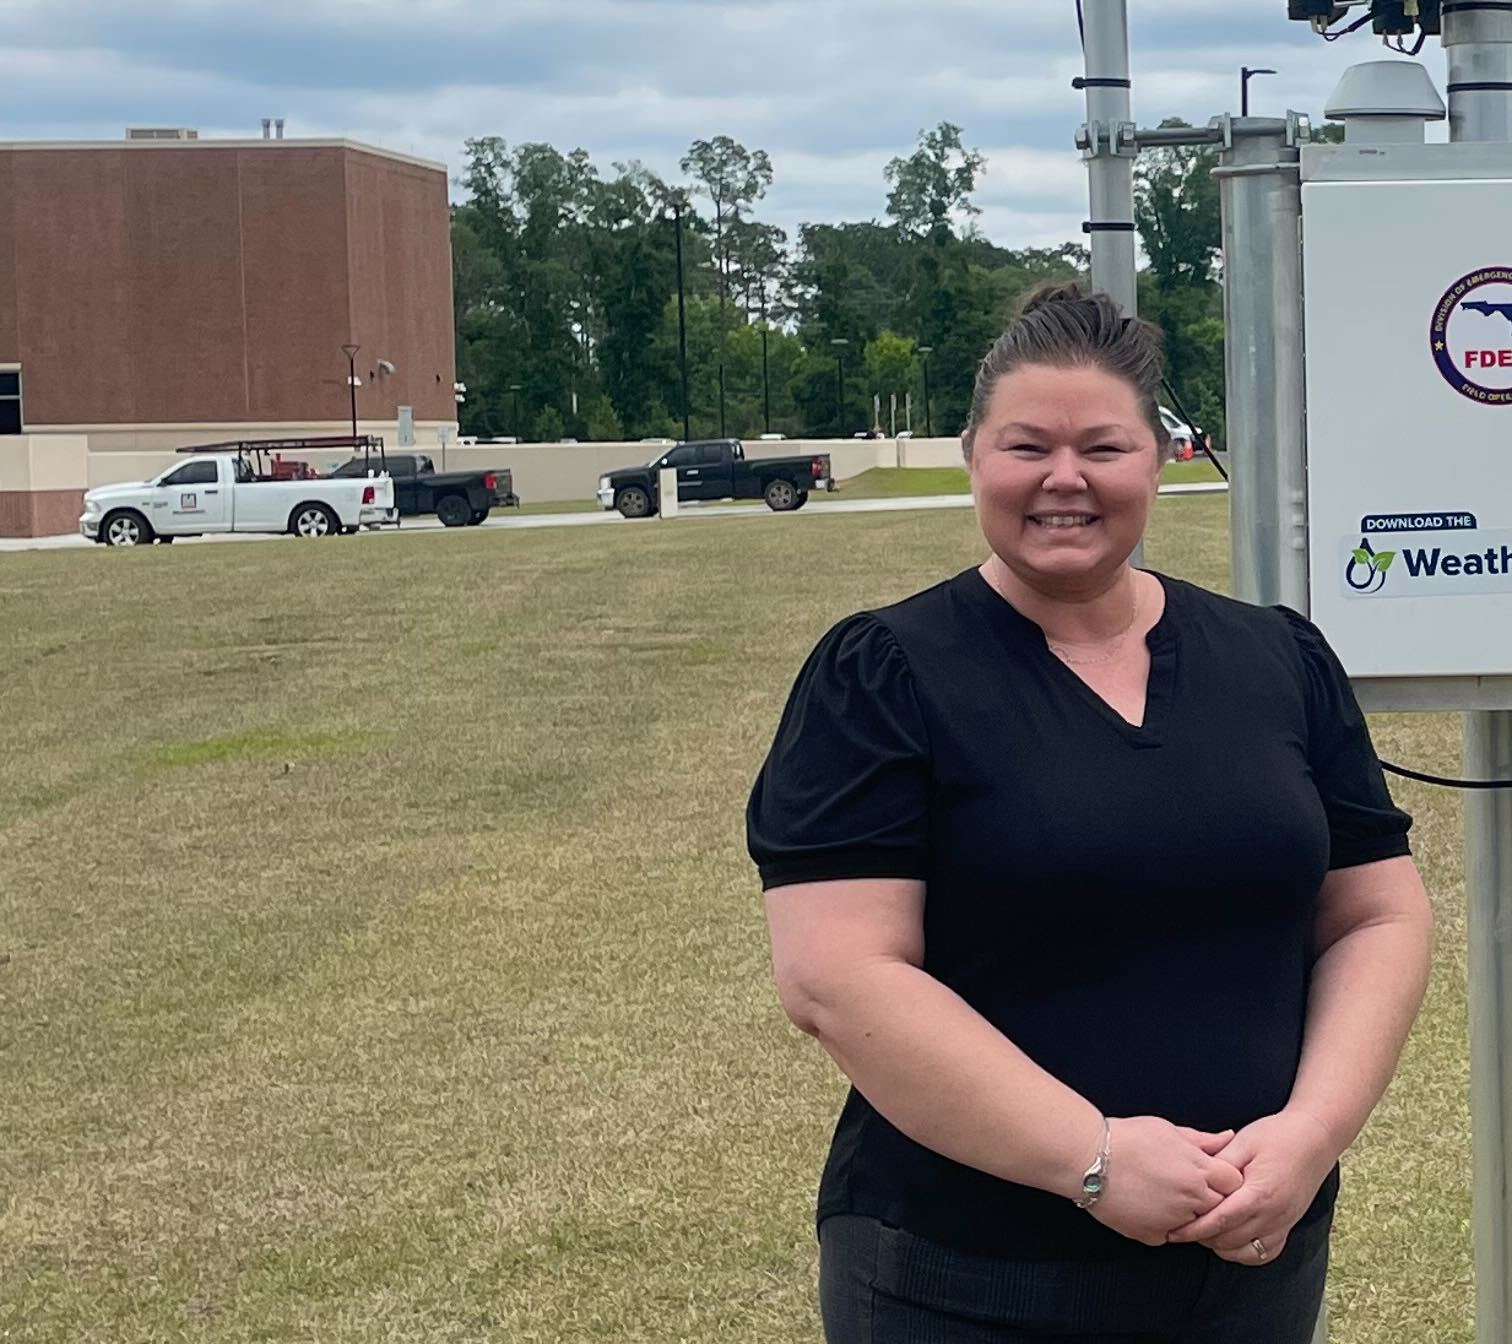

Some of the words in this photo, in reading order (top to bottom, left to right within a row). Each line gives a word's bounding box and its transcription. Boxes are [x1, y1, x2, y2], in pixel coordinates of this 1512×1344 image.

[1434, 293, 1457, 332] DIVISION
[1454, 283, 1465, 295] OF
[1461, 383, 1486, 400] FIELD
[1366, 517, 1443, 530] DOWNLOAD
[1446, 515, 1472, 527] THE
